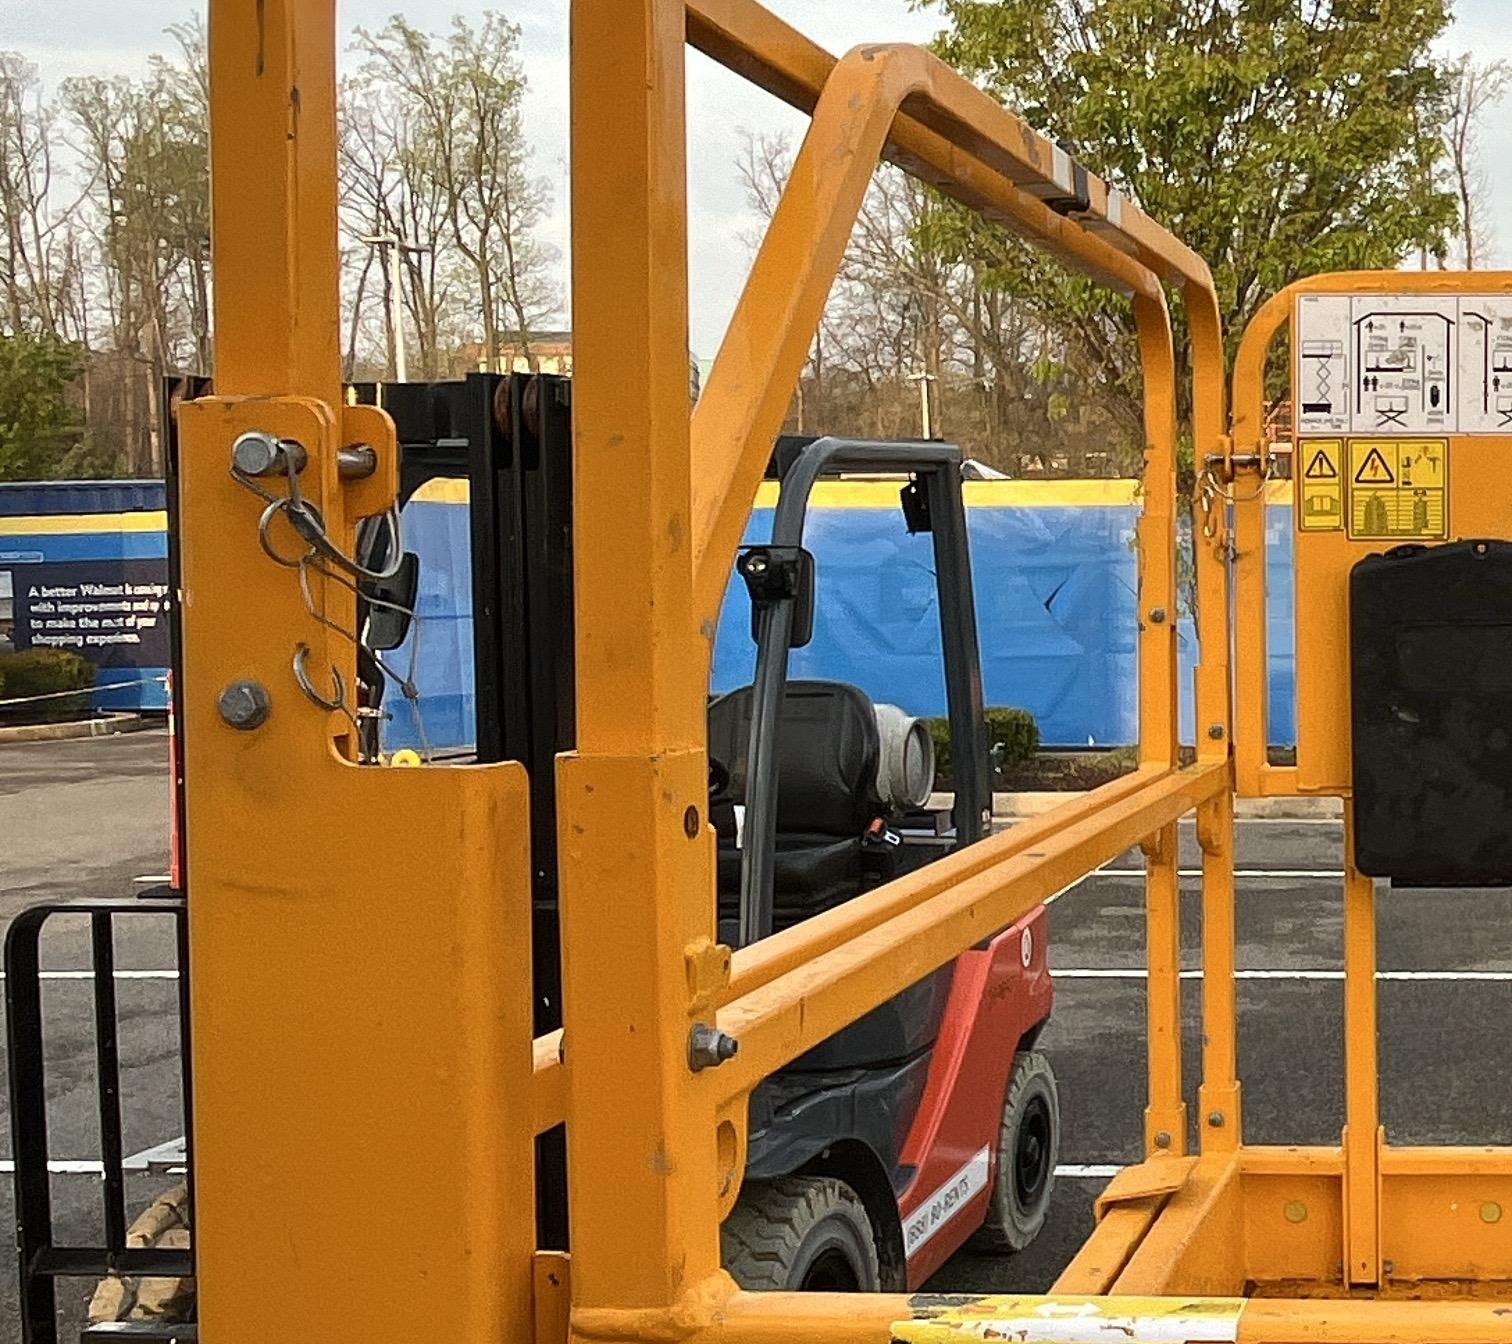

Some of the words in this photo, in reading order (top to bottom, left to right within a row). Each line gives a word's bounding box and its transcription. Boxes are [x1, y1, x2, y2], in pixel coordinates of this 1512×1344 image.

[28, 586, 39, 598] A
[41, 585, 77, 598] better
[78, 616, 99, 629] the
